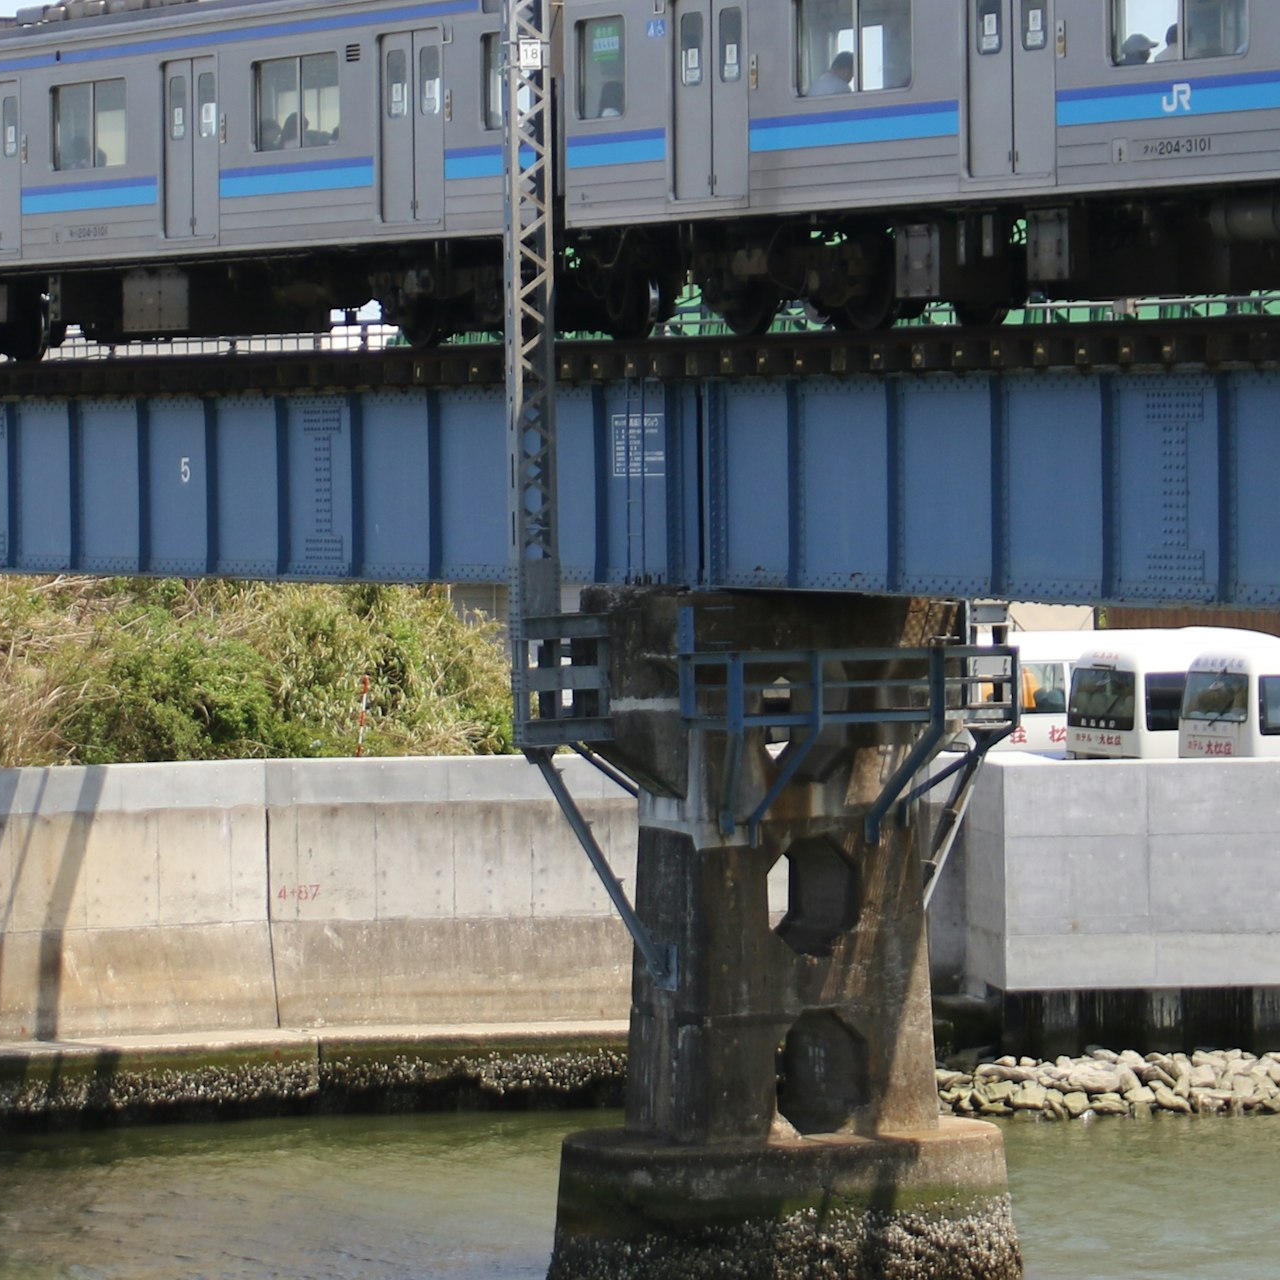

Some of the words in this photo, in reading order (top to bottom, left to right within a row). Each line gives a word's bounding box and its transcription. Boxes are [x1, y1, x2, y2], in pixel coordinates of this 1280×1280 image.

[523, 48, 538, 60] 18
[1162, 83, 1191, 112] JR
[180, 456, 191, 483] 5
